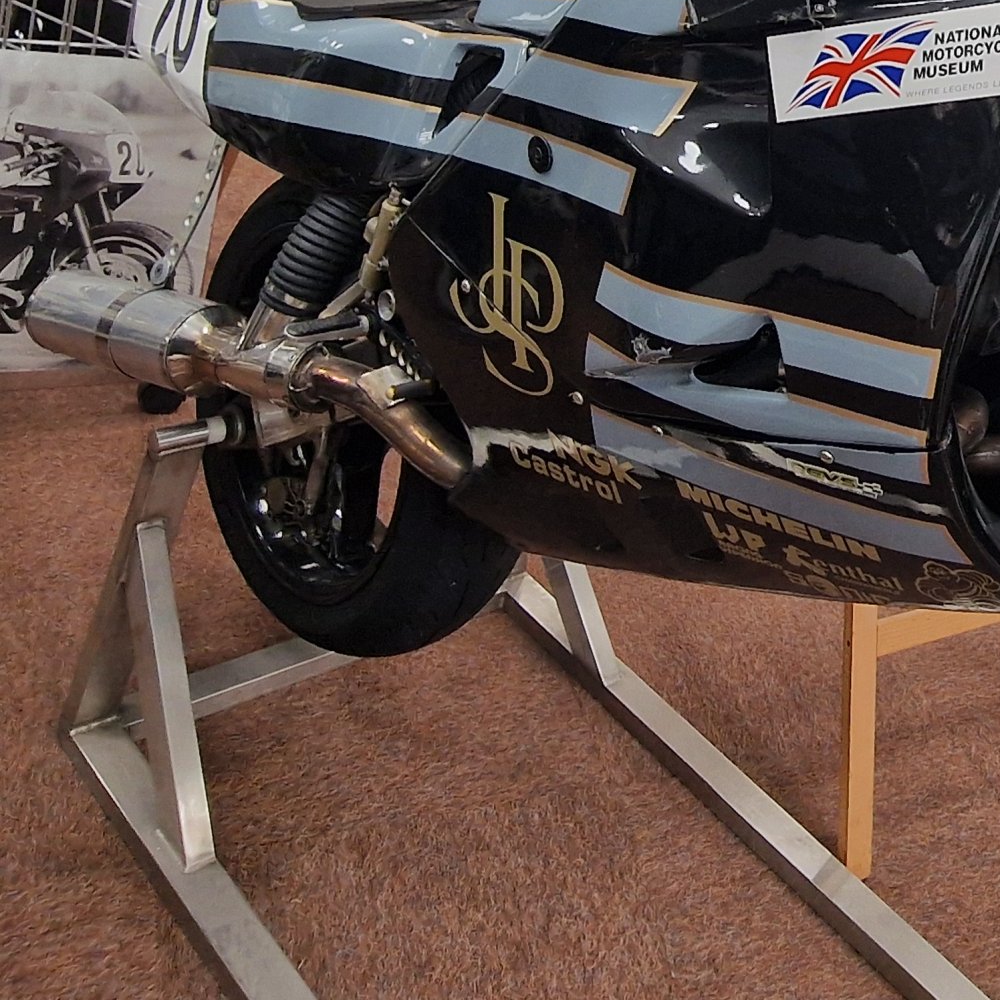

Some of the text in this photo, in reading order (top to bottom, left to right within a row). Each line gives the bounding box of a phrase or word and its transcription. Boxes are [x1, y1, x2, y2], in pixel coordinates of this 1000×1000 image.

[905, 87, 937, 98] WHERE
[943, 81, 989, 94] LEGENDS
[913, 59, 984, 80] MUSEUM
[509, 441, 623, 504] Castrol
[547, 427, 642, 490] NGK
[675, 478, 882, 563] MICHELIN
[783, 545, 904, 591] Renthal
